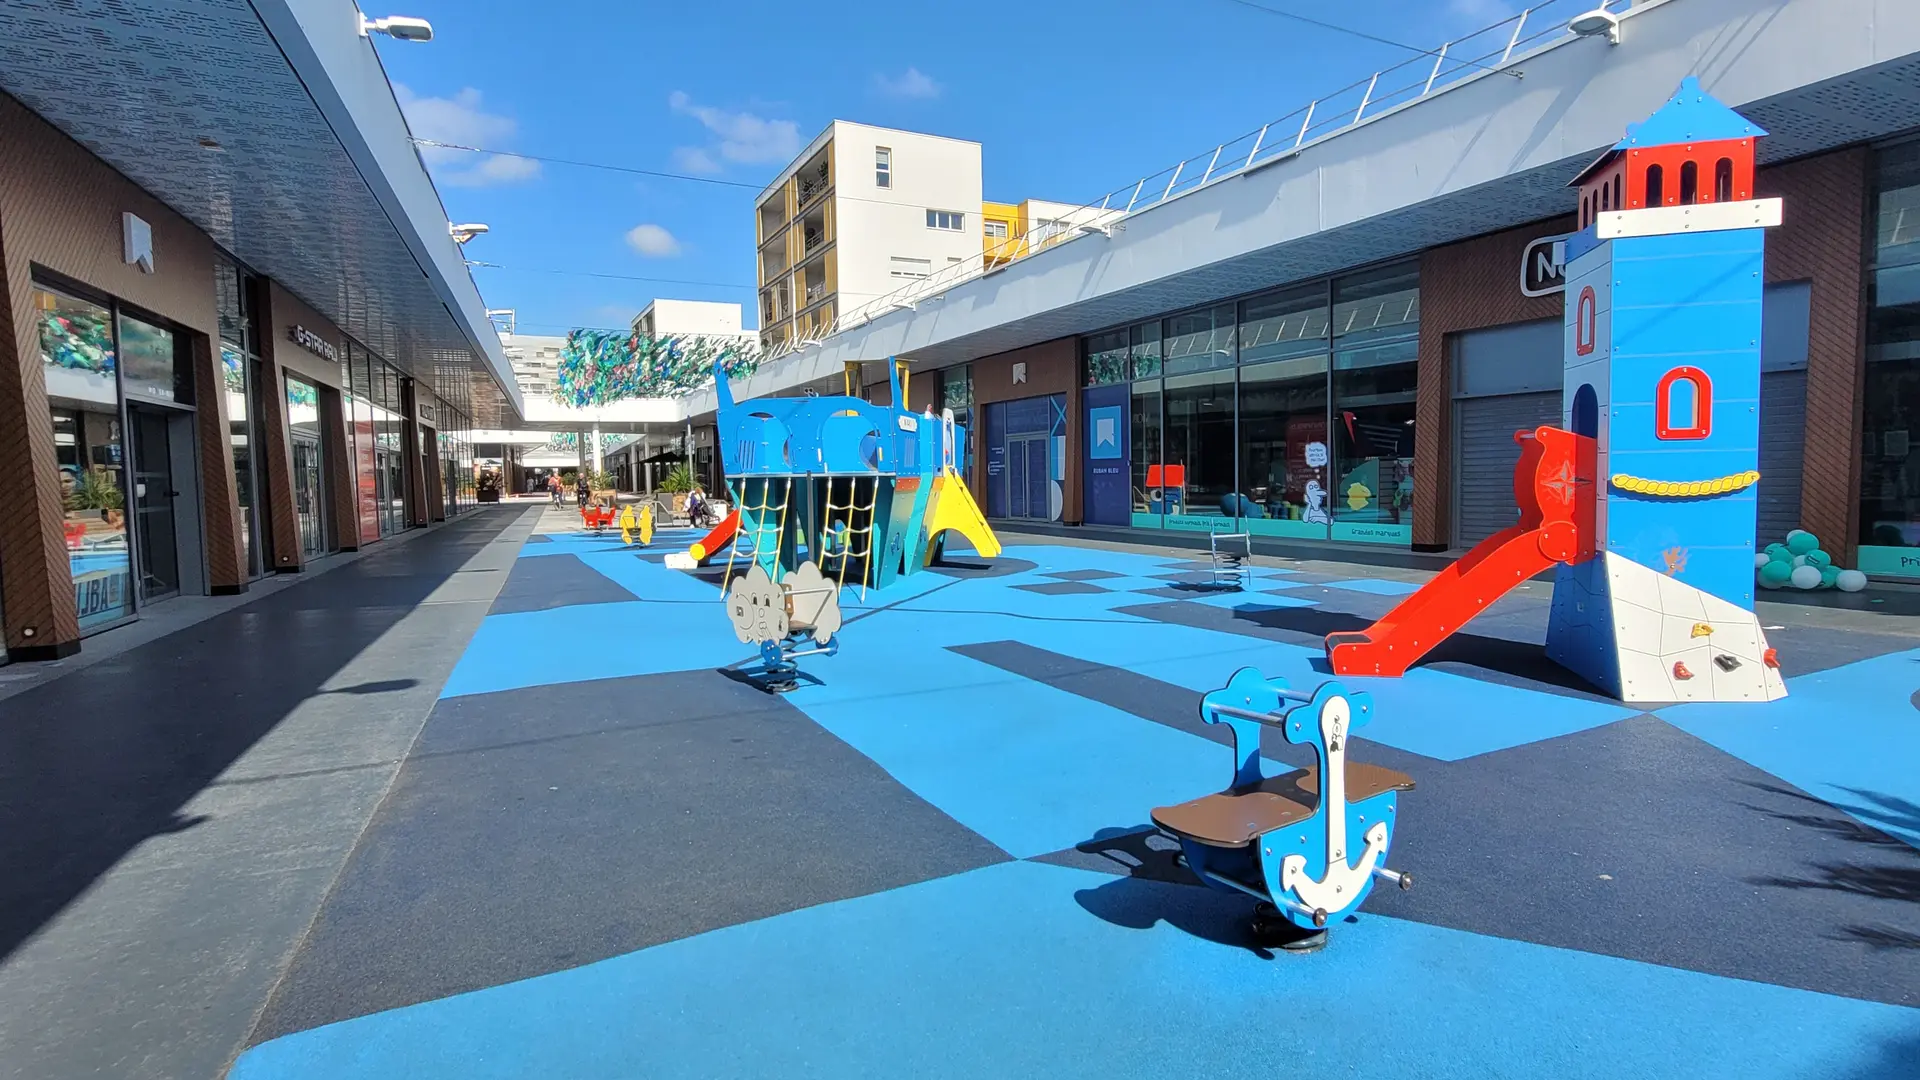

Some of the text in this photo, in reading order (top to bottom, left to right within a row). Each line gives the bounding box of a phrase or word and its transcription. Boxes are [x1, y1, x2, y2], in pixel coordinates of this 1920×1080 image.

[297, 324, 324, 355] G-STAR
[1351, 528, 1401, 538] Grandes marques
